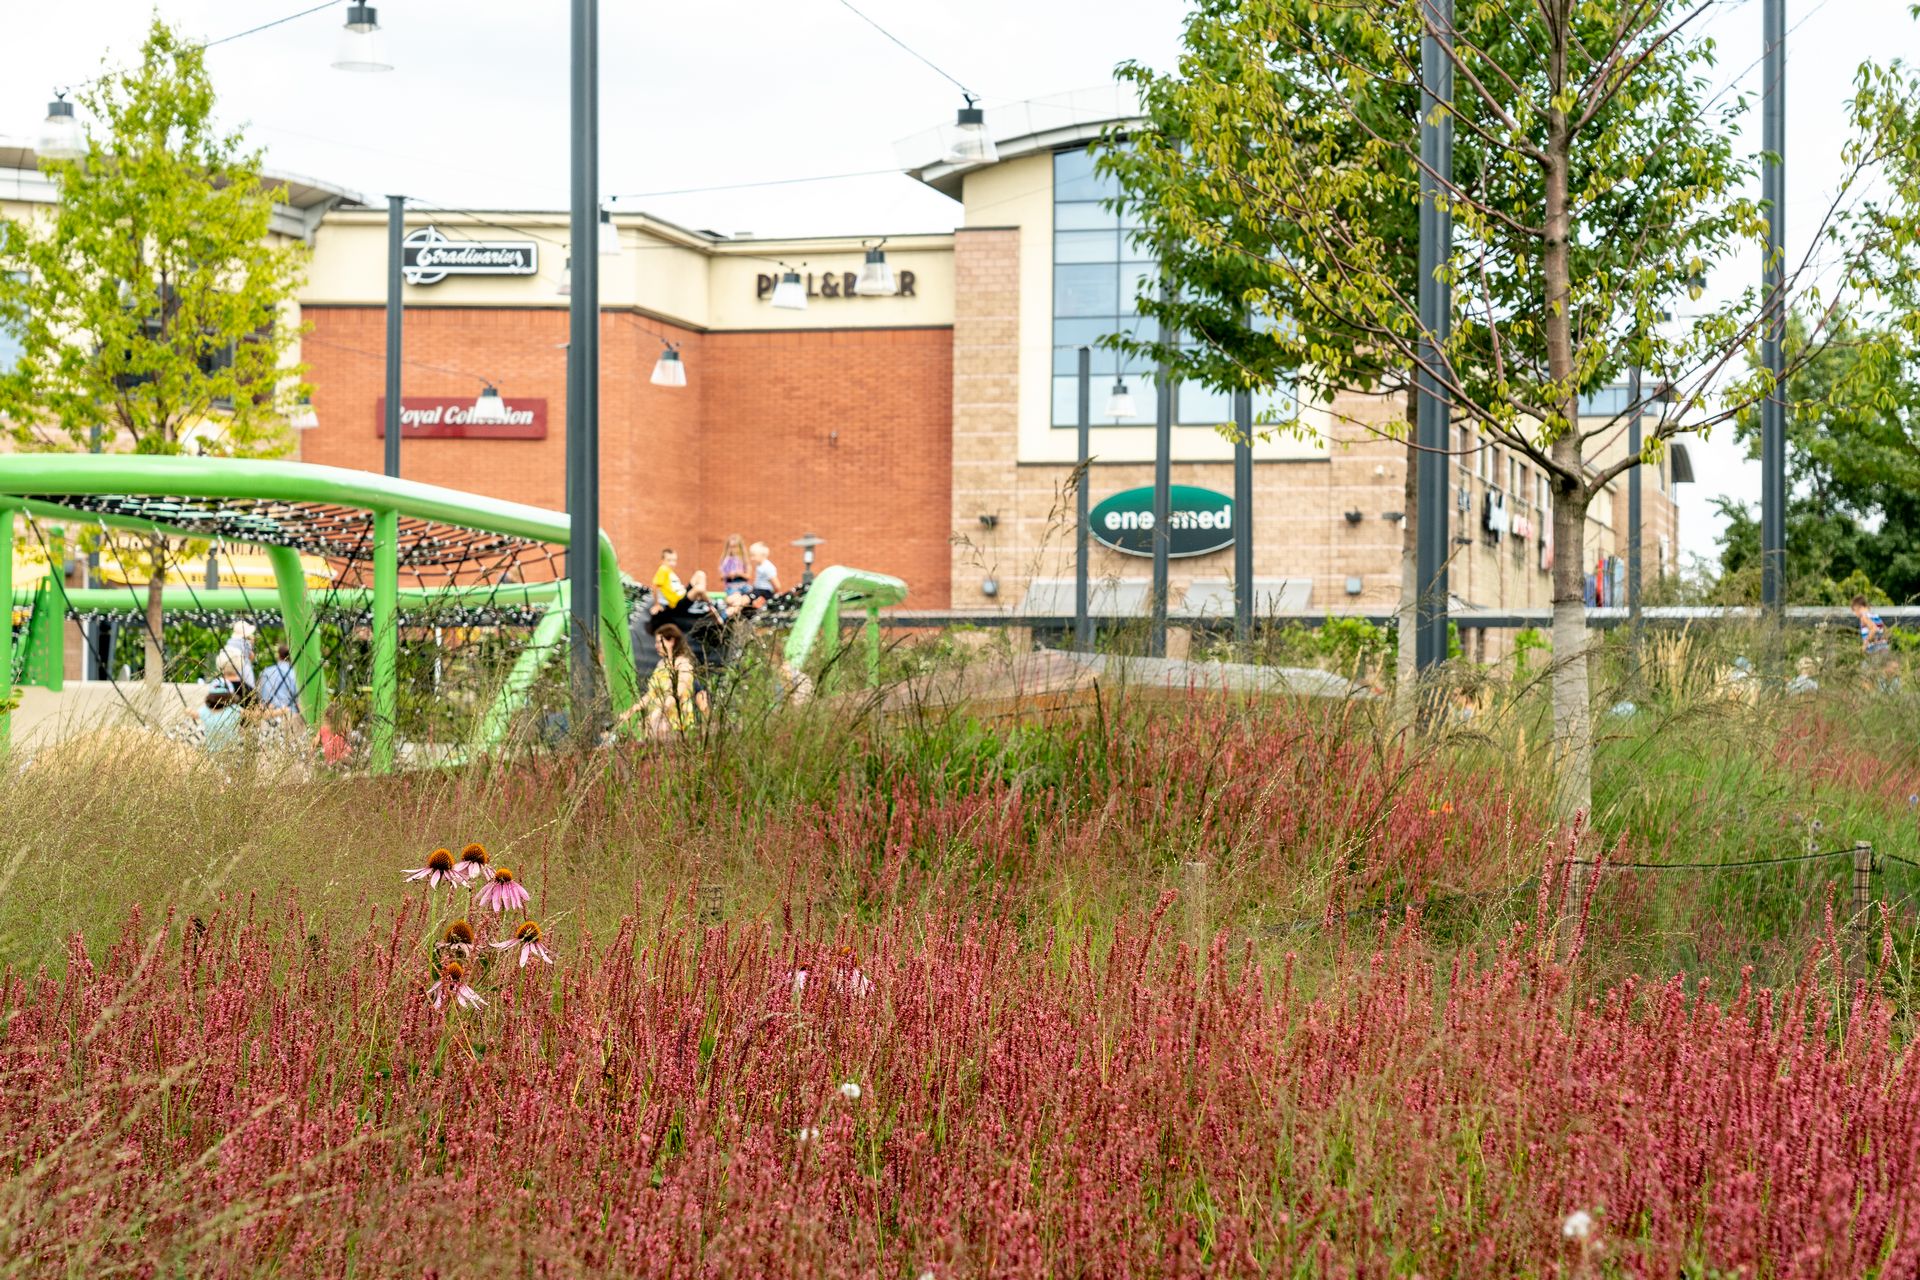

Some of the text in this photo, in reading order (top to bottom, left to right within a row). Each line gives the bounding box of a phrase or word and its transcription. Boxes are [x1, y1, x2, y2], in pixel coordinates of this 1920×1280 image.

[407, 225, 525, 284] Stradivarius
[757, 270, 916, 299] PL&BR
[1104, 504, 1231, 530] enemed
